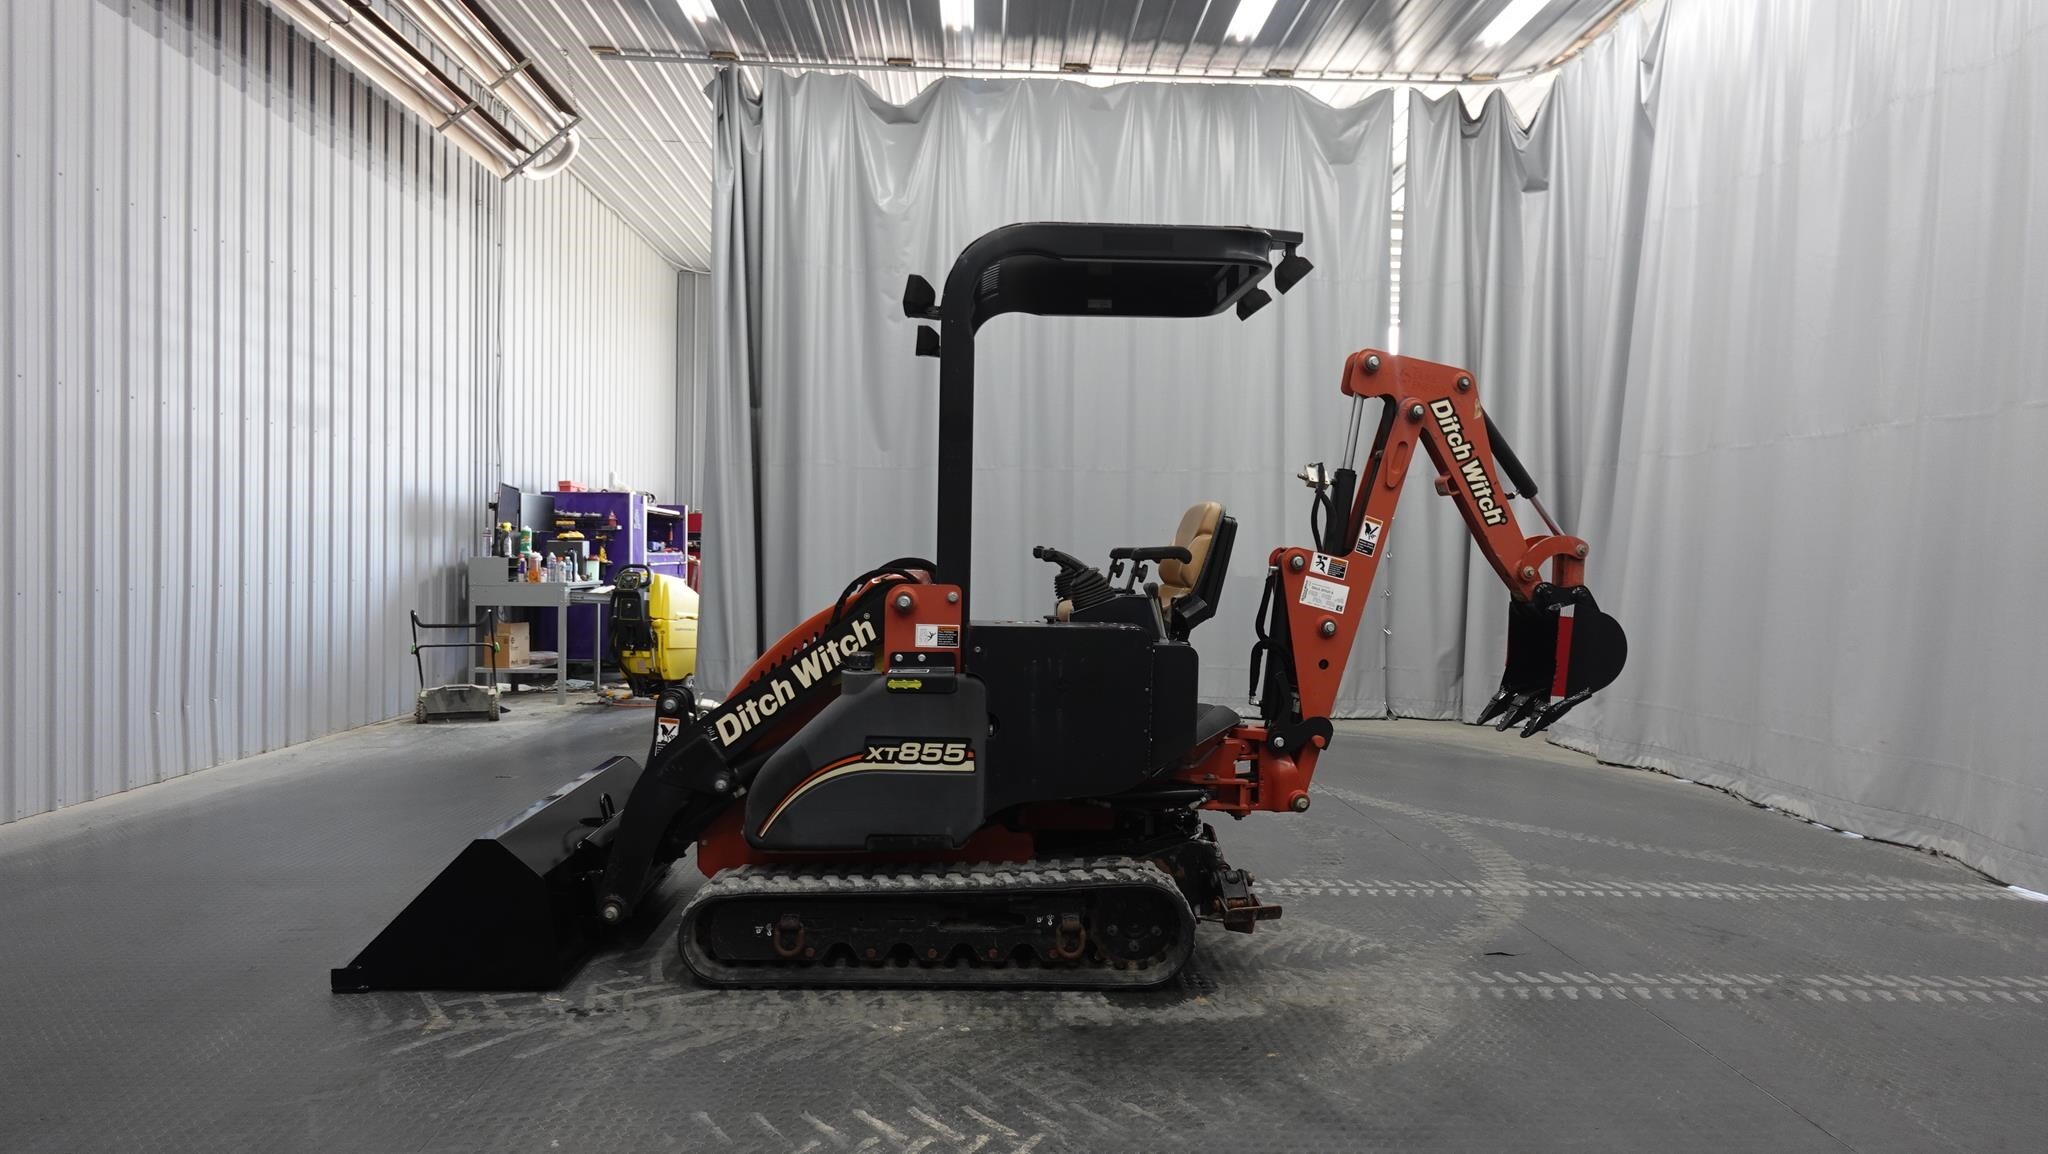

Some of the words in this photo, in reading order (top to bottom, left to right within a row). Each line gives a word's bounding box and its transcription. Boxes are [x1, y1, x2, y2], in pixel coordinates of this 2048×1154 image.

[1429, 399, 1474, 461] Ditch
[1461, 459, 1504, 526] Witch
[715, 678, 796, 747] Ditch
[790, 619, 877, 689] Witch
[866, 742, 967, 763] XT855
